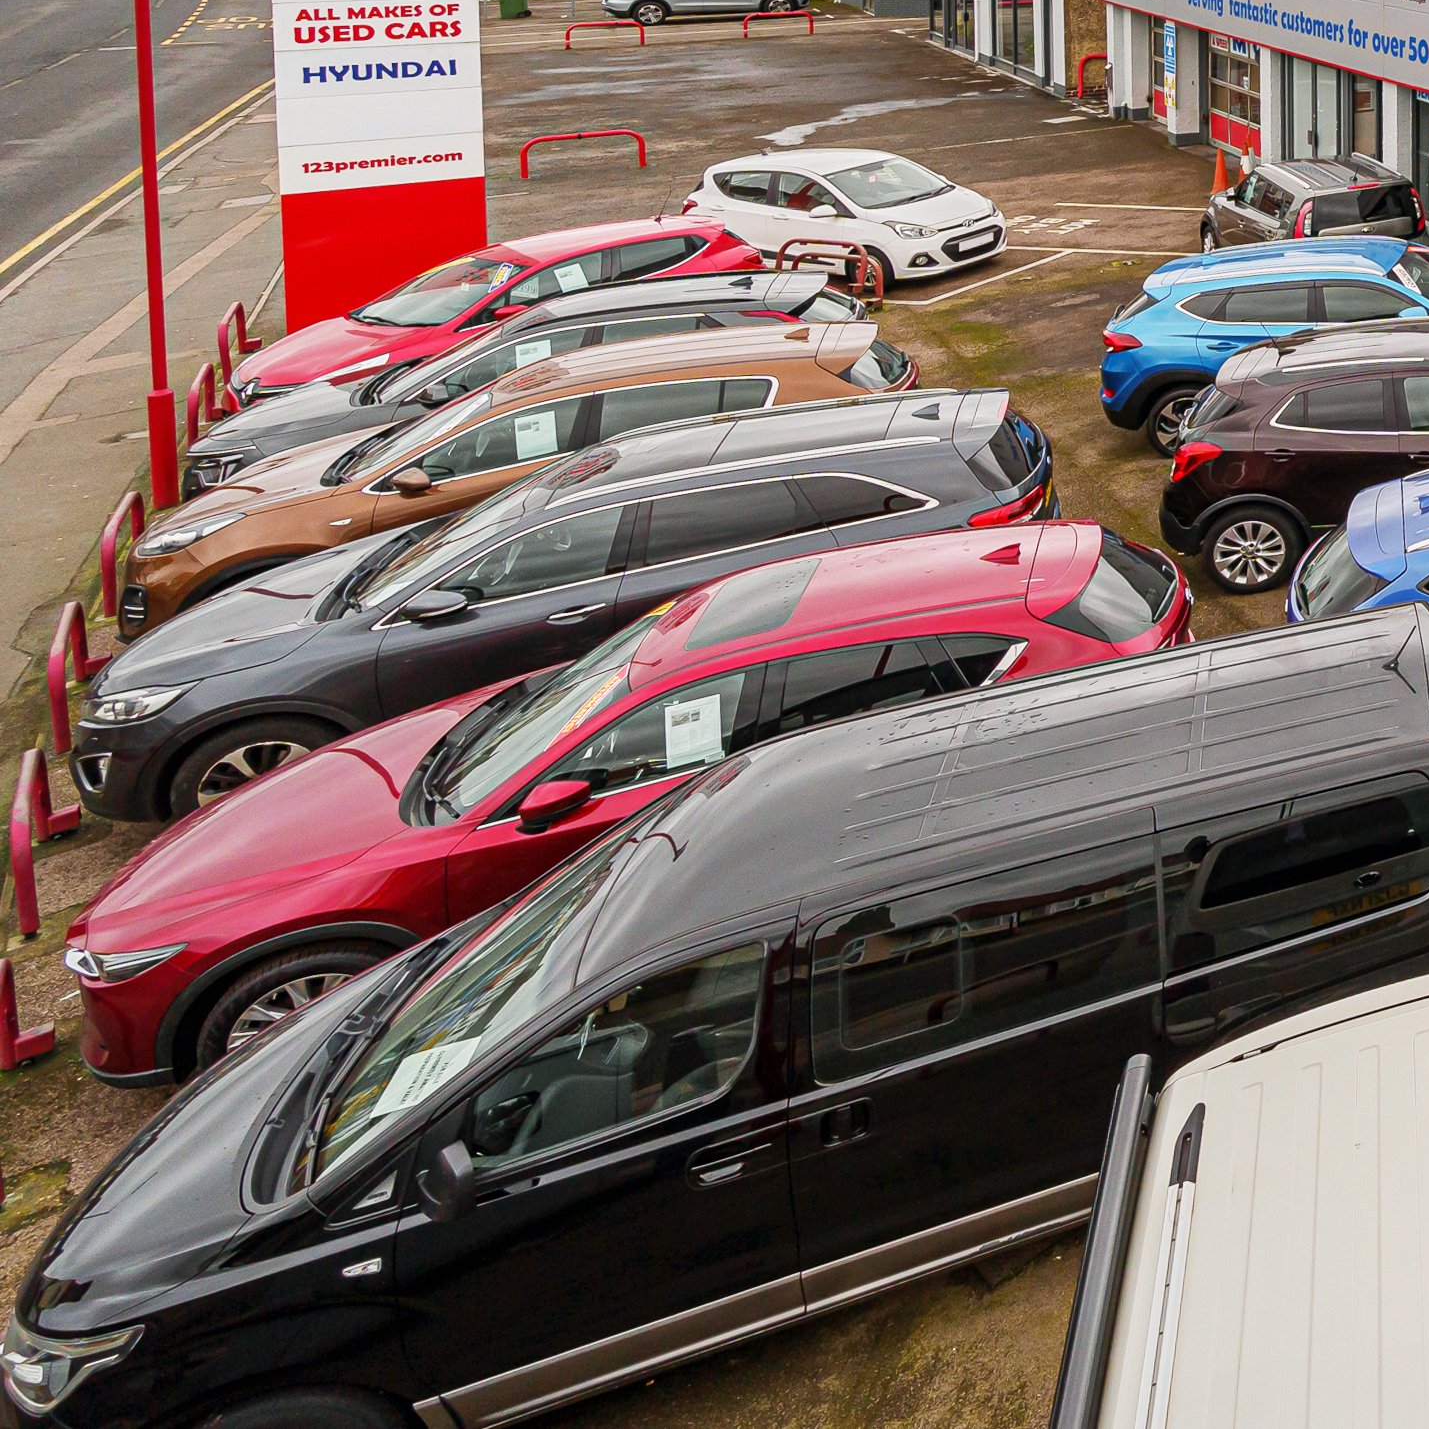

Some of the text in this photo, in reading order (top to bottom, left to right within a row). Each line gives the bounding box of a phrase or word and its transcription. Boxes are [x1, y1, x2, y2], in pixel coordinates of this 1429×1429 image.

[295, 3, 460, 22] ALL MAKES OF
[293, 20, 462, 44] USED CARS
[1281, 12, 1344, 43] customers
[1348, 19, 1369, 49] for
[1372, 34, 1406, 59] over
[1408, 36, 1429, 64] 50
[302, 59, 457, 84] HYUNDAI
[302, 152, 463, 174] 123premier.com
